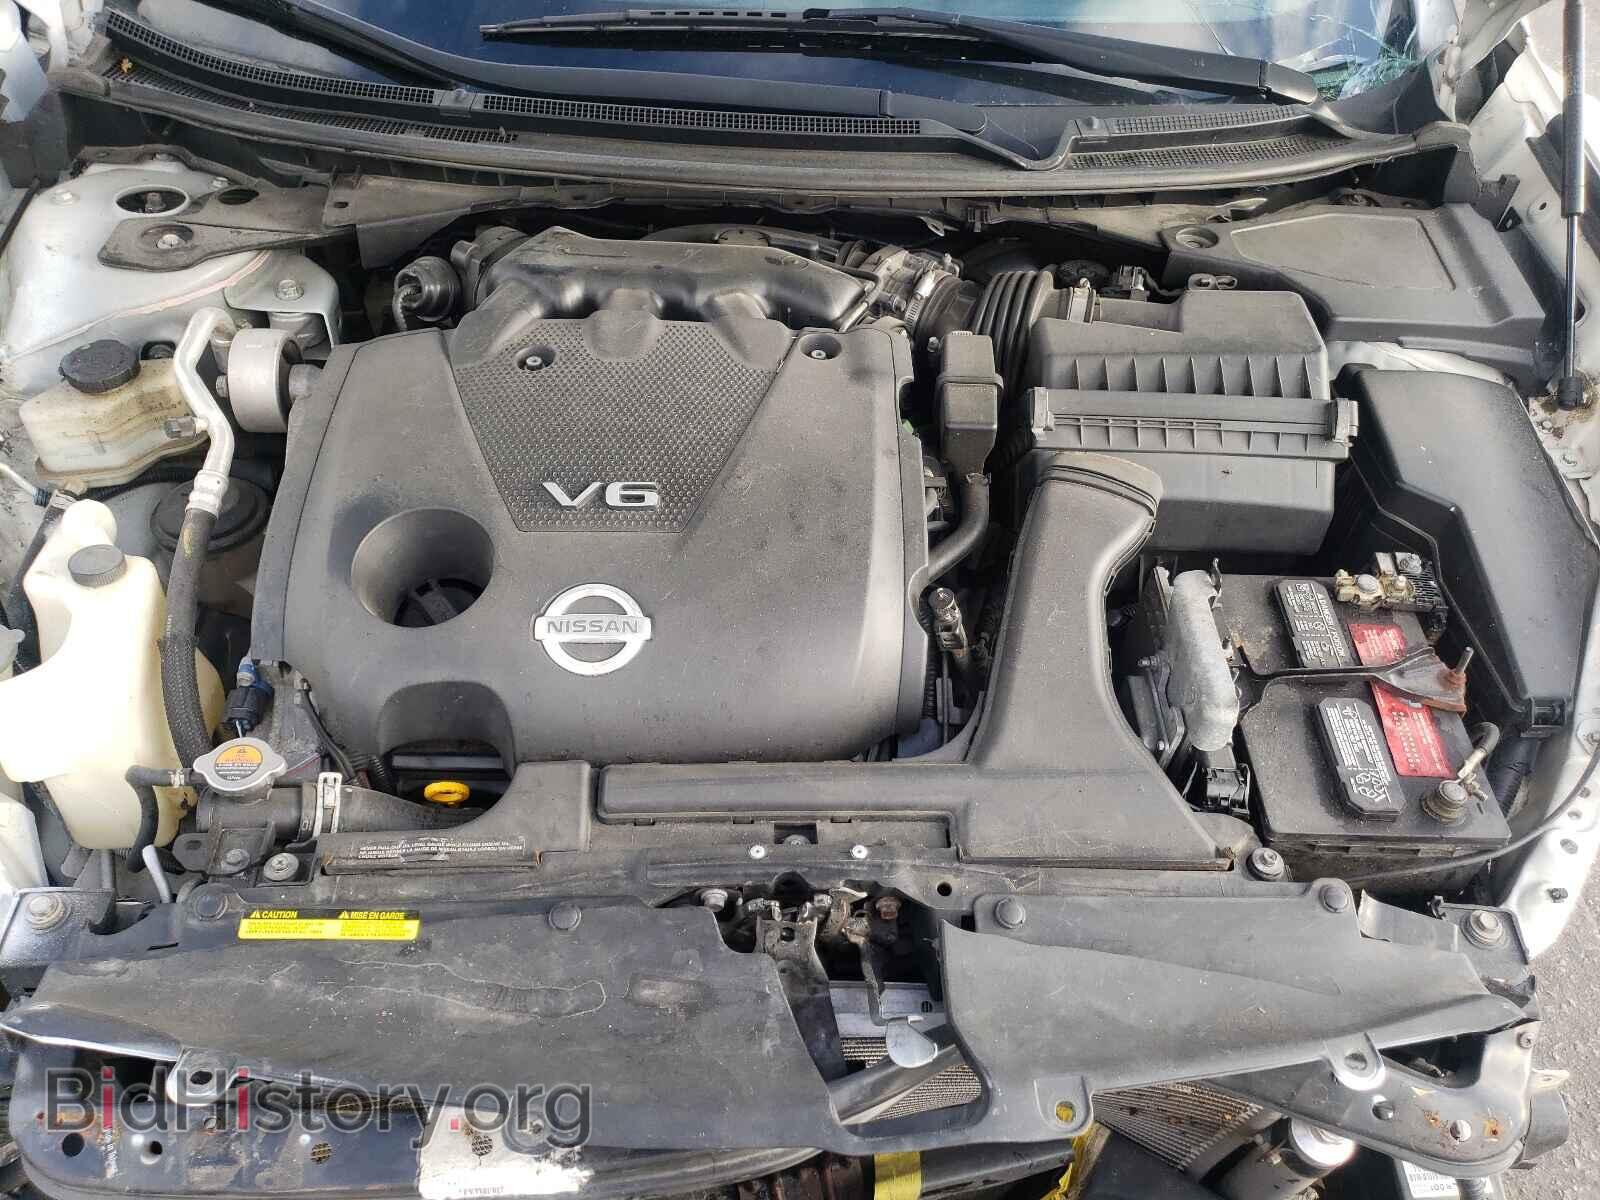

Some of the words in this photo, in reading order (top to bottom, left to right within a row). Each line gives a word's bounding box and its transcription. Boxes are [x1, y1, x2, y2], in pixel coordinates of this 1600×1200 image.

[542, 481, 659, 508] V6
[547, 619, 639, 634] NISSAN
[261, 910, 298, 919] CAUTION
[350, 911, 368, 919] MISE
[369, 911, 380, 919] EN
[380, 911, 405, 920] GARDE
